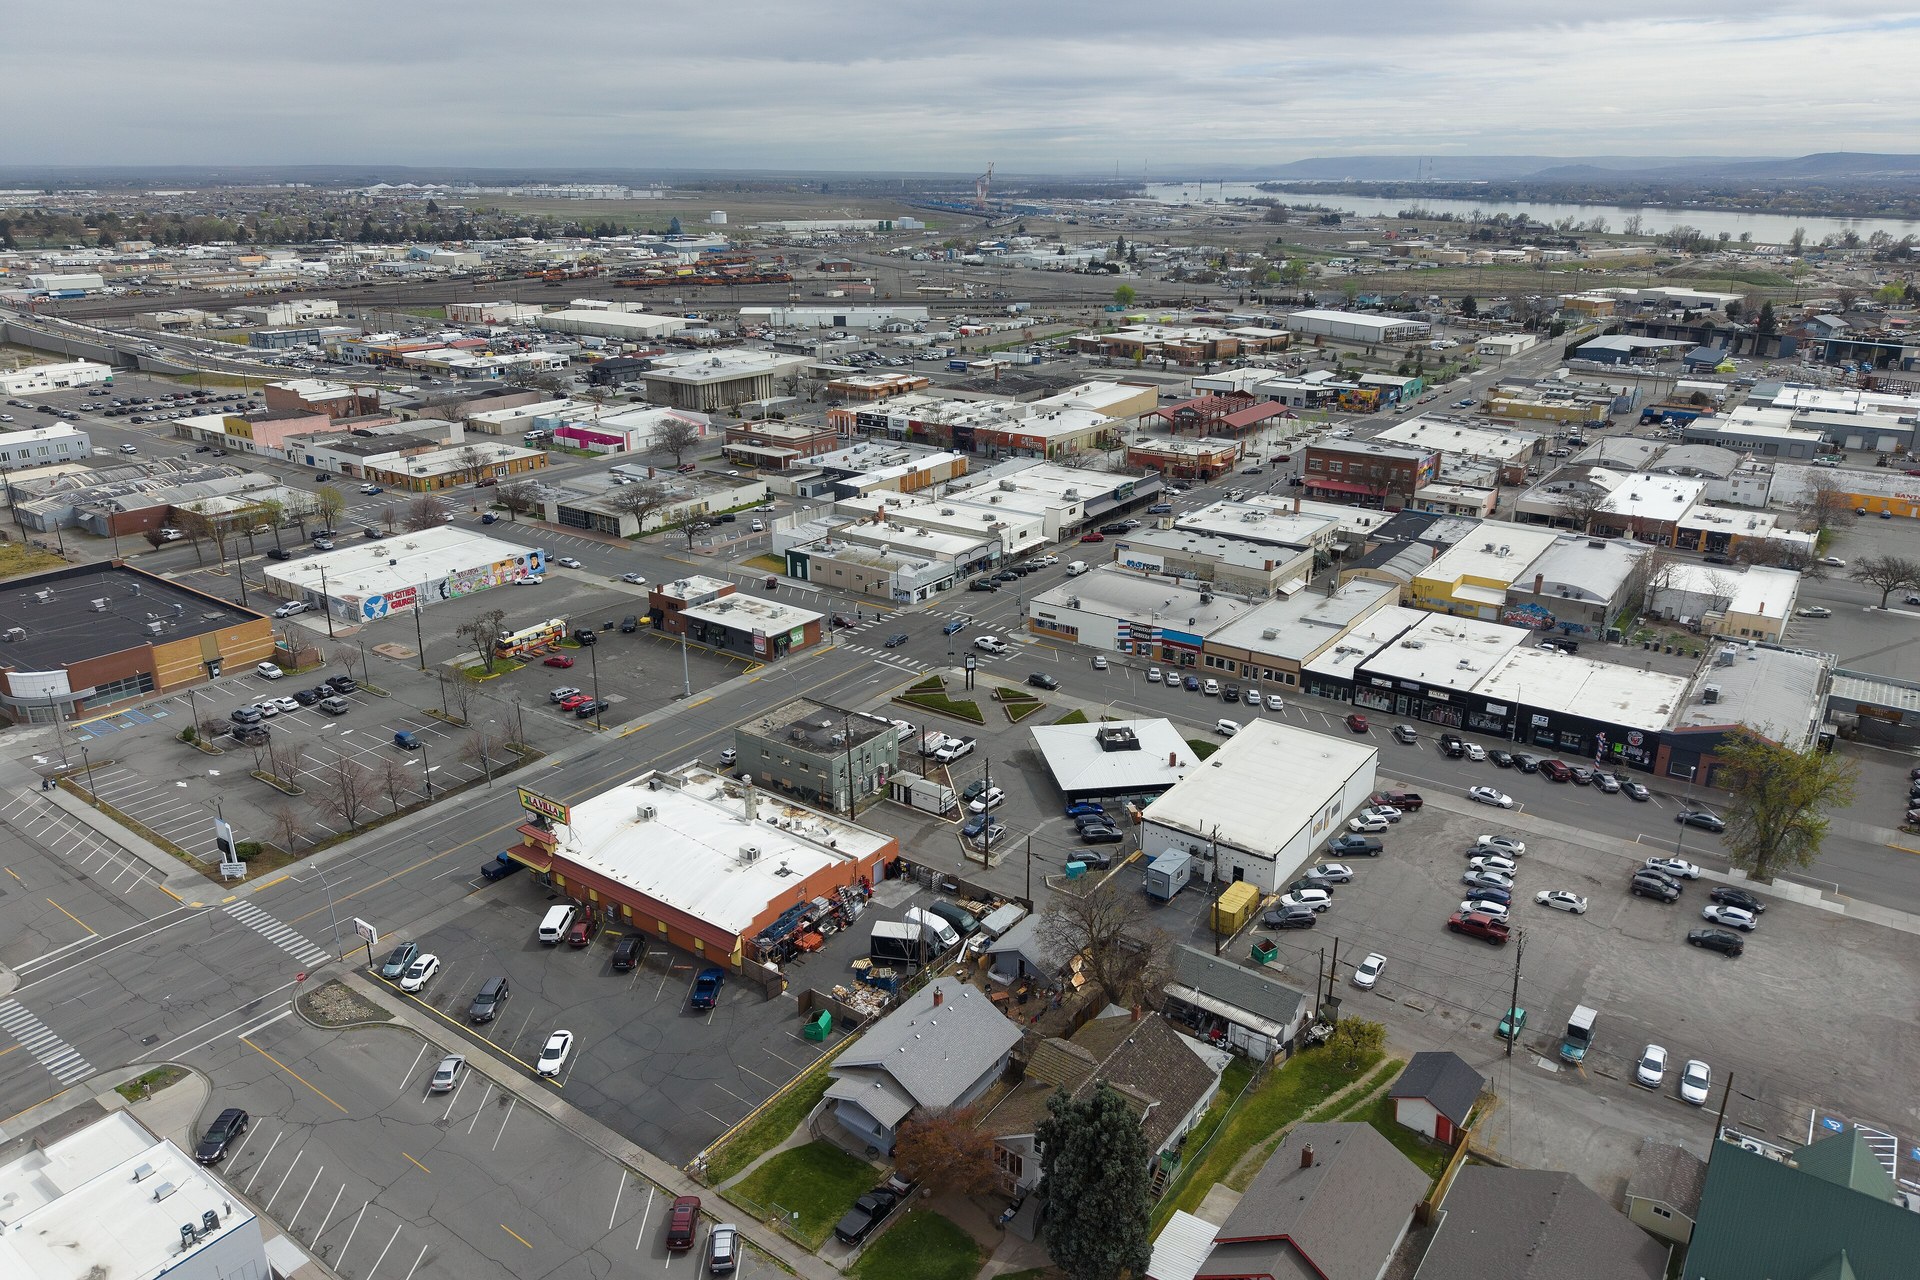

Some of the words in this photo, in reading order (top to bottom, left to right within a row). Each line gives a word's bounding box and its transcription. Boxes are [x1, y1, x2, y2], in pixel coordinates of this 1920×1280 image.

[1894, 492, 1920, 500] SANT
[384, 587, 417, 601] TRI-CITIES
[391, 597, 416, 609] CHURCH
[791, 631, 803, 643] TAX
[528, 795, 538, 807] LA
[538, 799, 559, 816] VILLA
